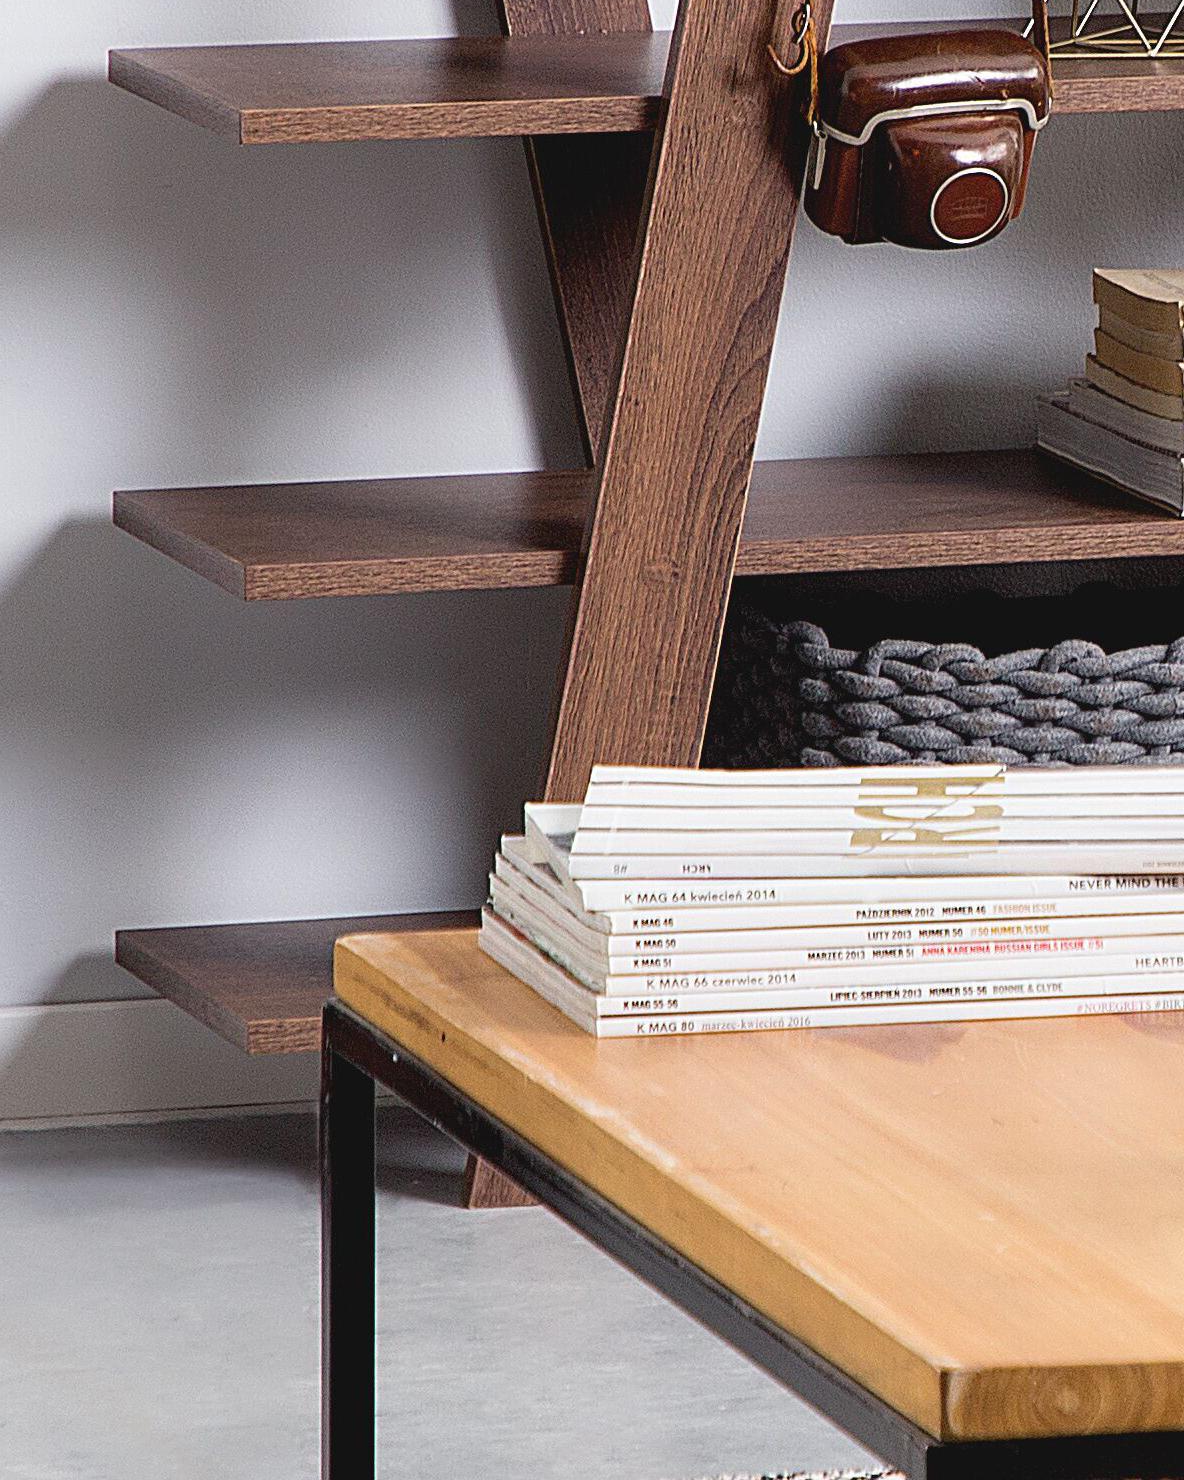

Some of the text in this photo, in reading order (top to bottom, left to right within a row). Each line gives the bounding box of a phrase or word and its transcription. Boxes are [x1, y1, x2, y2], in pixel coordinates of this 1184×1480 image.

[1069, 879, 1111, 891] NEVER
[1116, 877, 1151, 889] MIND
[1155, 876, 1180, 888] THE
[624, 890, 776, 904] K MAG 64 kwiecień 2014
[915, 908, 935, 917] 2012
[942, 906, 974, 916] NUMER
[633, 920, 638, 929] K
[641, 919, 660, 928] MAG
[868, 931, 889, 941] LUTY
[892, 930, 912, 940] 2013
[919, 928, 949, 938] NUMER
[952, 928, 963, 937] 50
[635, 939, 676, 949] K MAG 50
[808, 951, 842, 961] MARZEC
[846, 950, 865, 960] 2013
[872, 949, 903, 959] NUMER
[906, 949, 914, 958] 51
[922, 946, 944, 956] ANNA
[633, 958, 672, 968] K MAG 51
[647, 974, 797, 990] K MAG 66 czerwiec 2014
[902, 989, 922, 999] 2013
[929, 987, 961, 998] NUMER
[1036, 983, 1063, 993] CLYDE
[623, 1001, 629, 1011] K
[632, 1000, 650, 1010] MAG
[637, 1023, 647, 1033] K
[649, 1021, 677, 1033] MAG
[681, 1020, 694, 1031] 80
[787, 1016, 811, 1028] 2016
